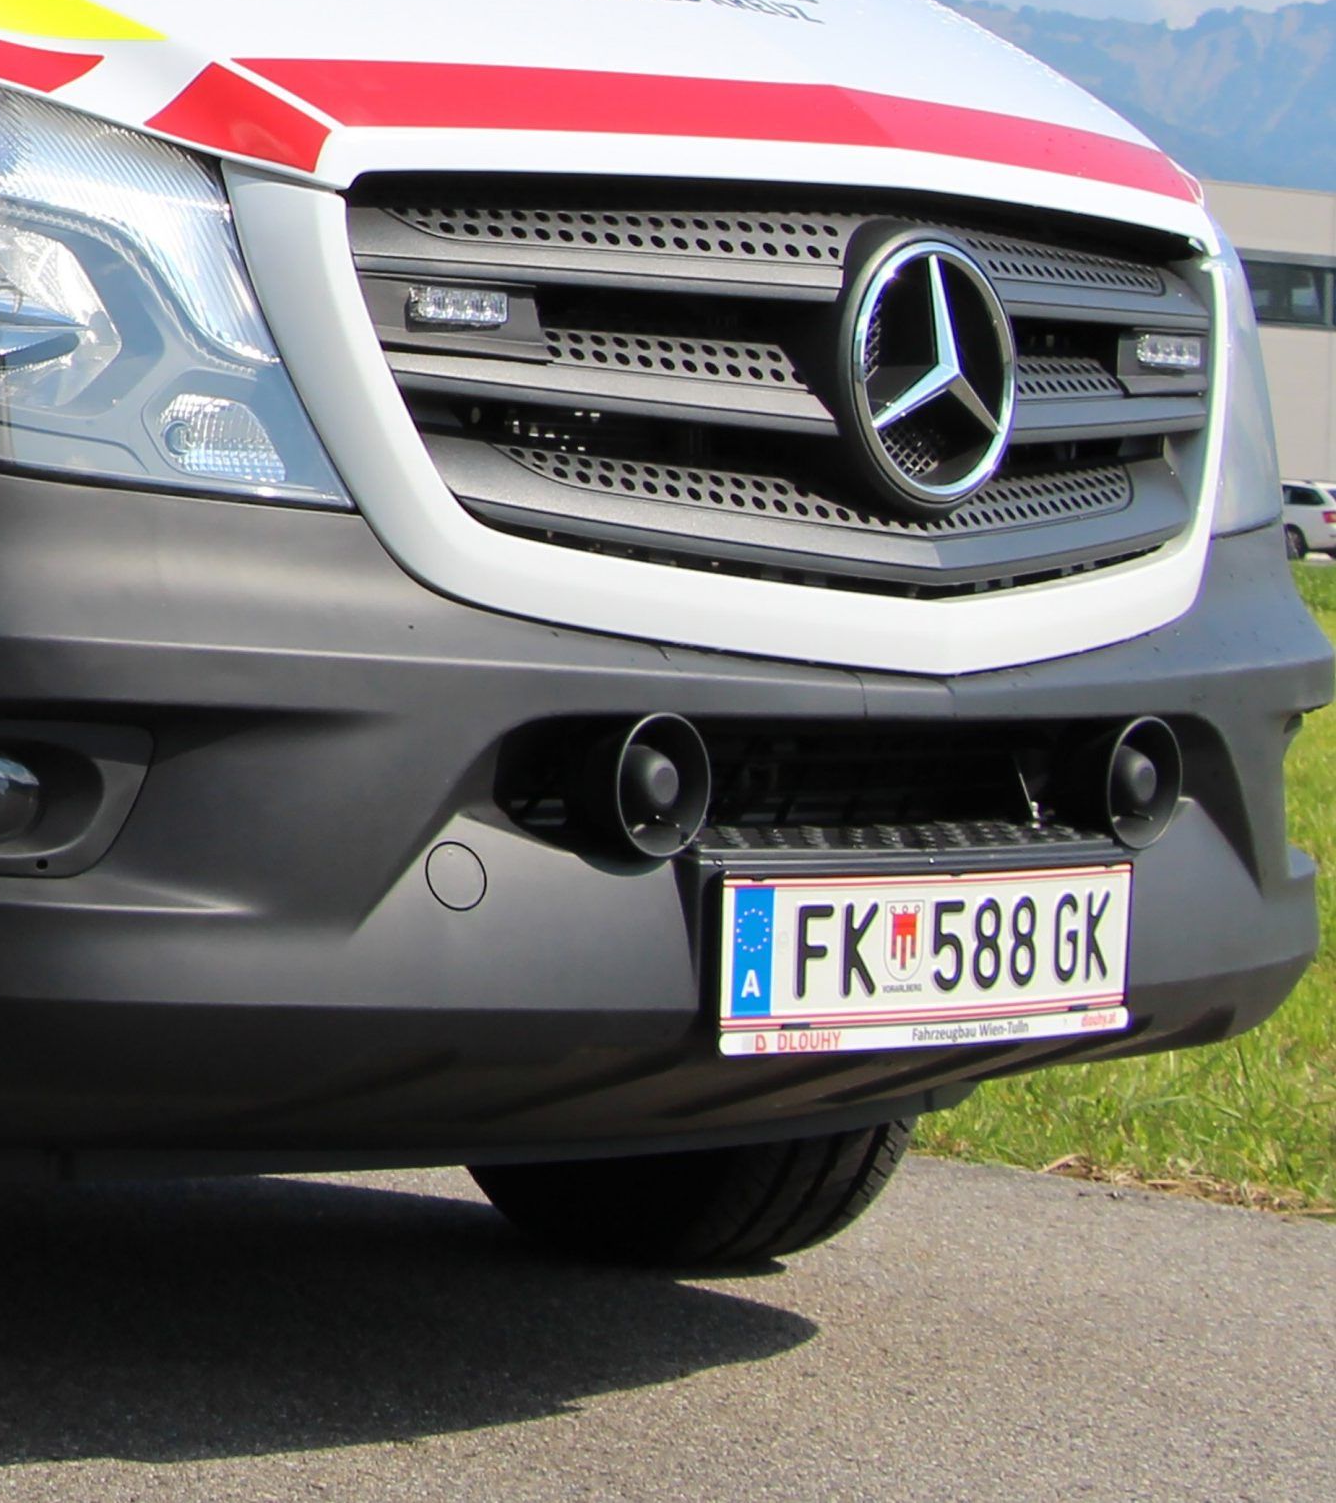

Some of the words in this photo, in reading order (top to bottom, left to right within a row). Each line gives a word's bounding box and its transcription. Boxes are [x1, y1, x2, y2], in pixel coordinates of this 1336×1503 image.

[793, 901, 879, 999] FK
[931, 894, 1037, 992] 588
[1053, 890, 1112, 983] GK
[741, 969, 761, 999] A
[777, 1030, 842, 1052] DLOUHY
[911, 1025, 977, 1043] Fahrzeugbau
[978, 1019, 1030, 1038] Wien-Tulln
